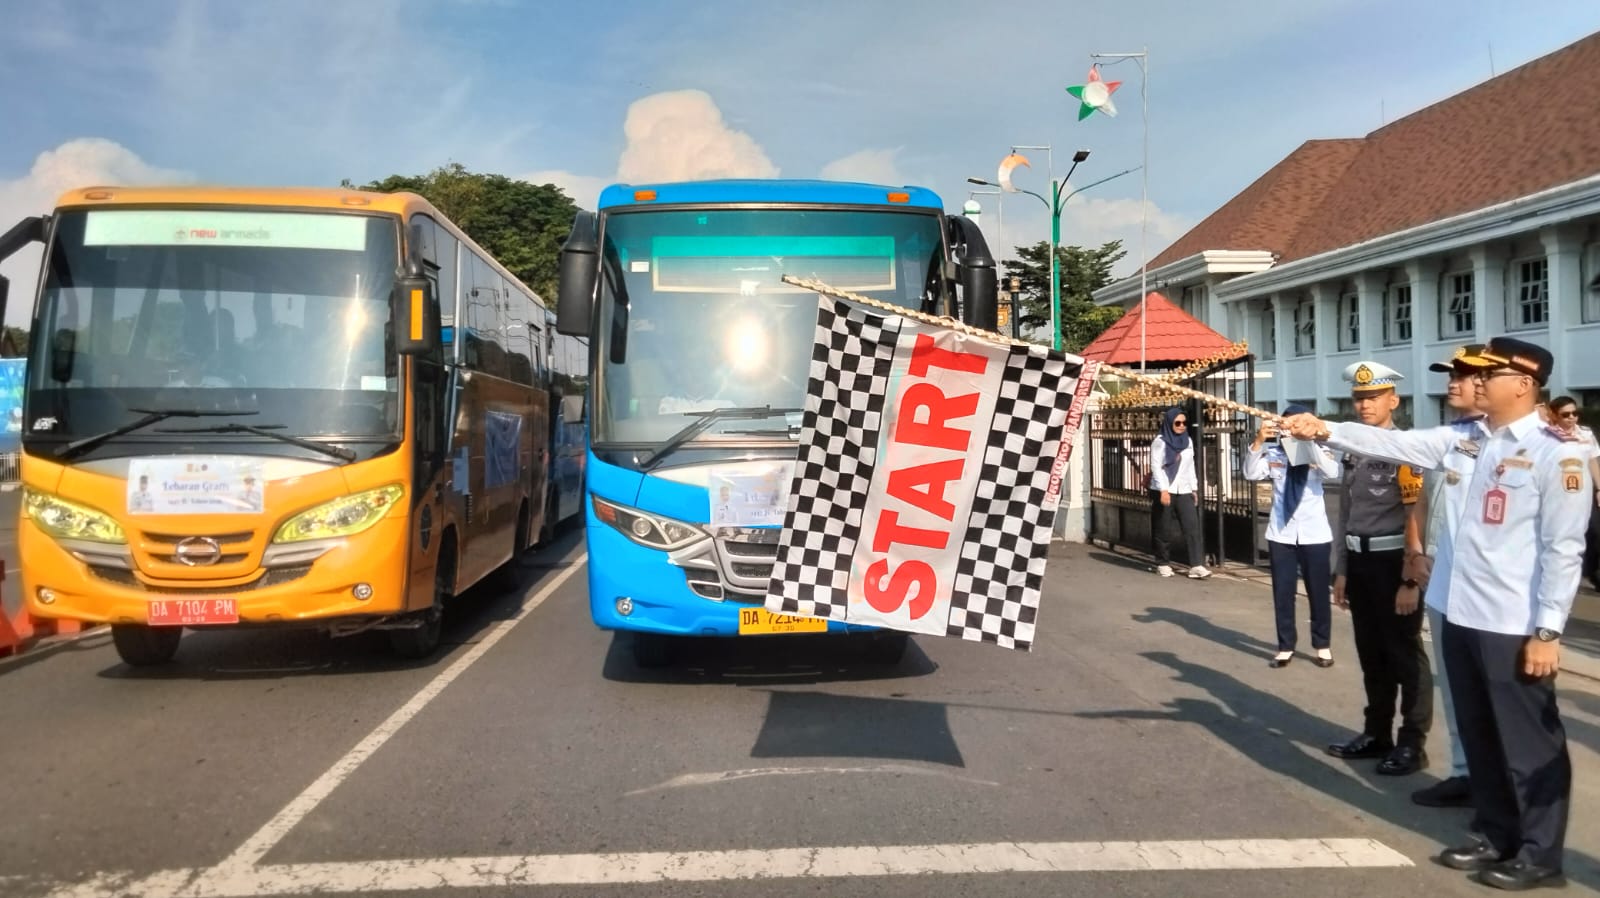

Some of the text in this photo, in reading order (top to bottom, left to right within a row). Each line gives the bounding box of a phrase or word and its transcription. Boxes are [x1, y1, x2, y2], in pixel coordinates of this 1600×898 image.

[190, 229, 217, 239] new
[864, 333, 988, 620] START
[152, 599, 234, 616] DA 7104 PM
[743, 611, 759, 625] DA
